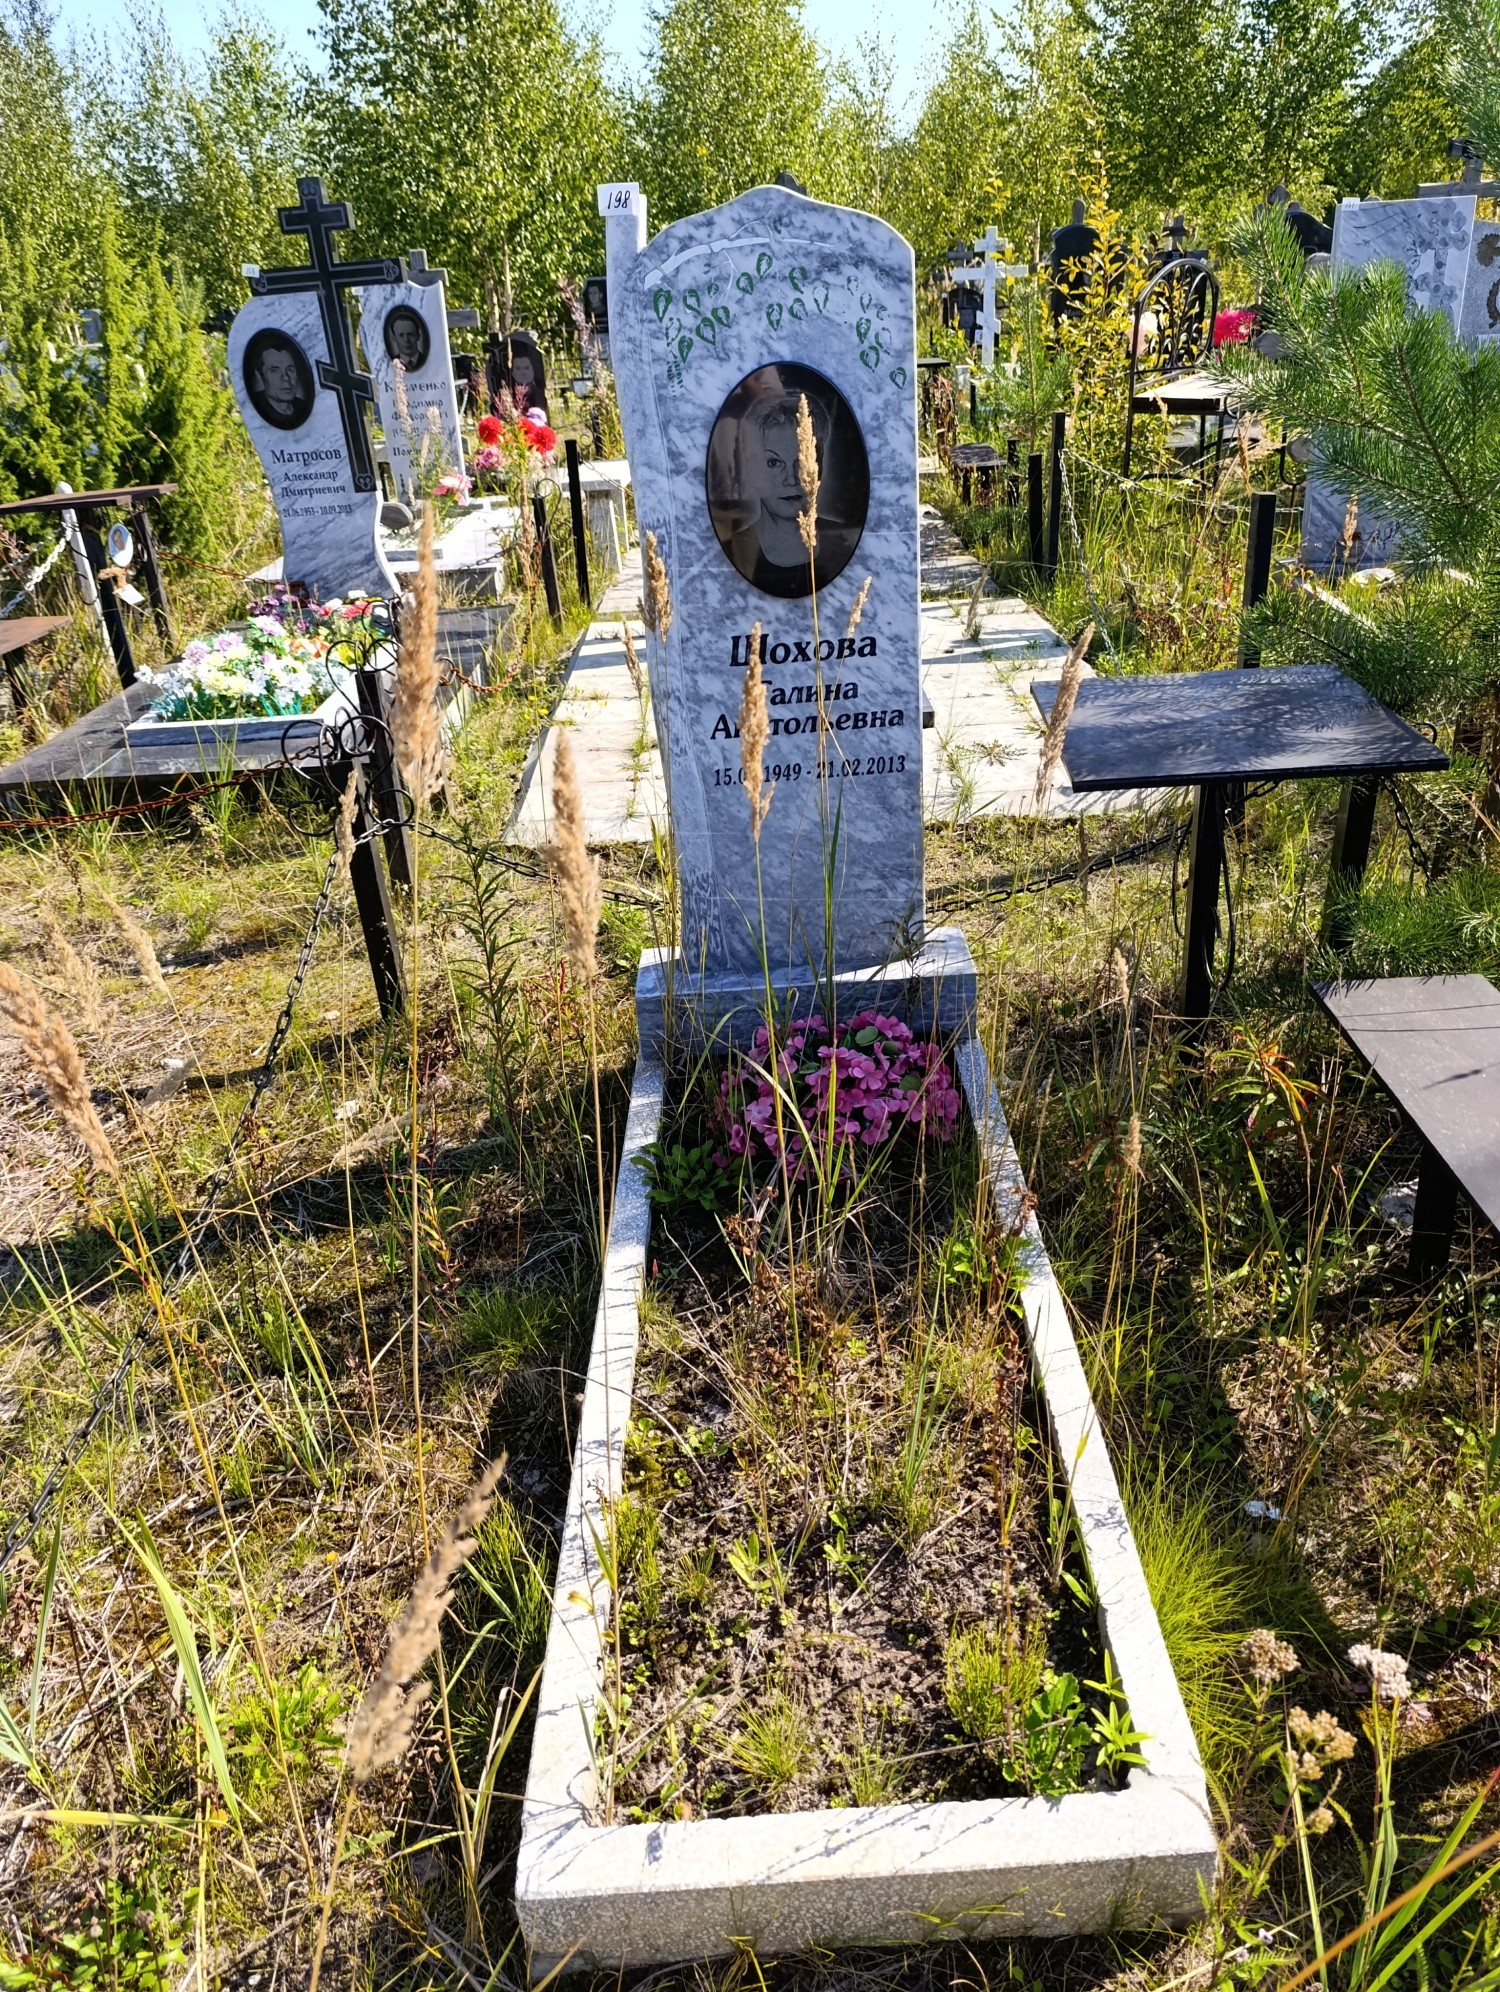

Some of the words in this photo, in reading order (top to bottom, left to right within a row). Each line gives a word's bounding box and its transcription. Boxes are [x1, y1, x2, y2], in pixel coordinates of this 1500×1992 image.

[607, 190, 631, 209] 198
[270, 449, 342, 467] Матросов
[283, 471, 339, 482] Александр
[281, 485, 346, 499] Дмитриевич
[729, 633, 878, 667] Шохова
[758, 679, 859, 706] алина
[710, 708, 905, 740] Атольевна
[816, 754, 906, 779] 21.02.2013
